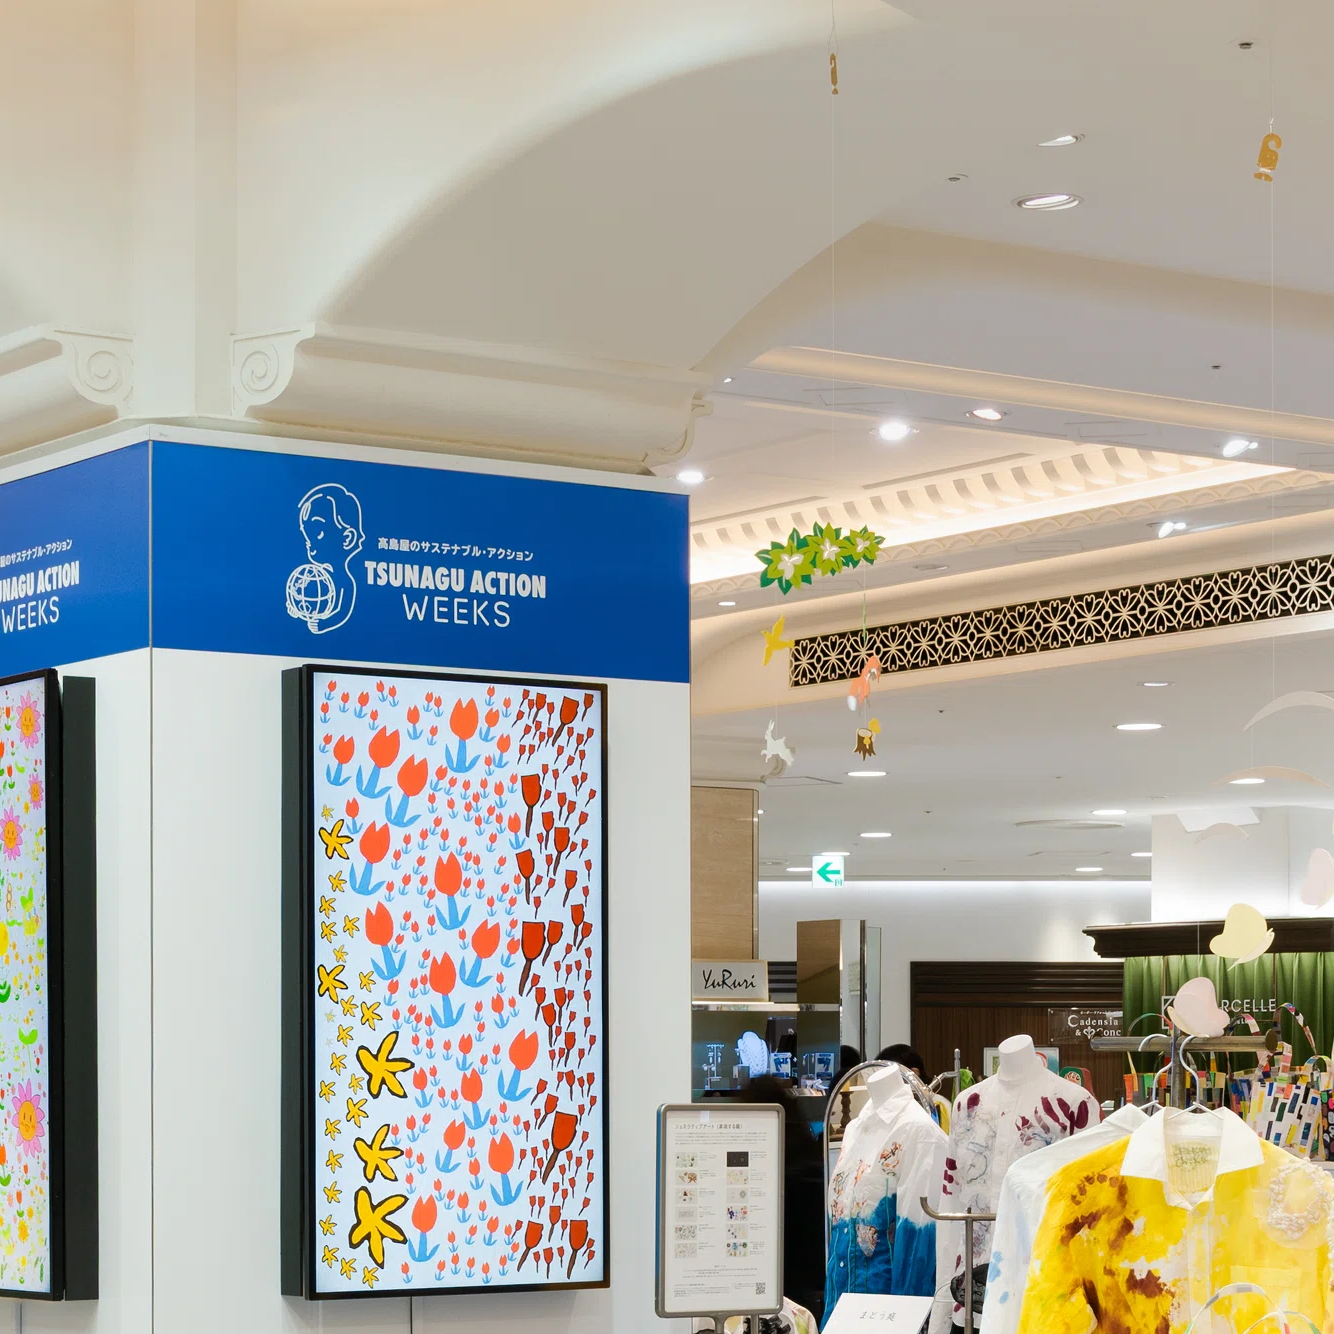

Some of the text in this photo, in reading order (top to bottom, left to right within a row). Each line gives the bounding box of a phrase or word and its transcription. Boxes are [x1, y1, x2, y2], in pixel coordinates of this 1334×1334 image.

[36, 560, 80, 595] ACTION
[364, 560, 547, 599] TSUNAGU ACTION
[1, 595, 60, 634] WEEKS
[402, 593, 511, 628] WEEKS
[702, 968, 757, 991] YuRuri
[1067, 1014, 1119, 1028] Cadensia
[1221, 998, 1277, 1013] RCELLE
